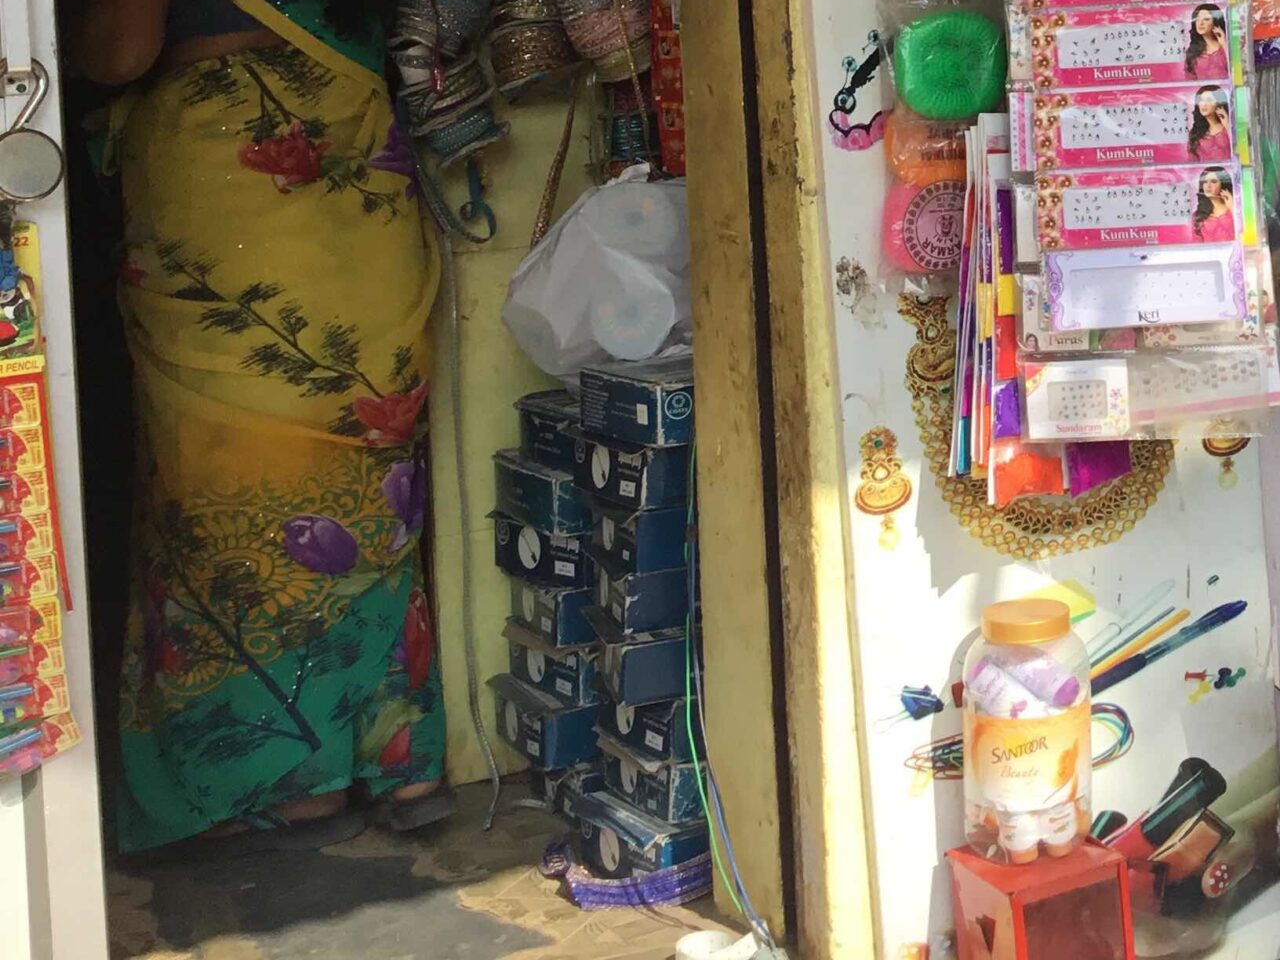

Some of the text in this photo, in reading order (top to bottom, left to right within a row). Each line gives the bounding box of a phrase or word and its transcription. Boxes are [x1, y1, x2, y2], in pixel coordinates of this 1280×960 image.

[1093, 67, 1151, 80] KumKum
[1096, 147, 1155, 160] KumKum
[1100, 228, 1159, 241] KumKum
[6, 359, 40, 373] PENCIL
